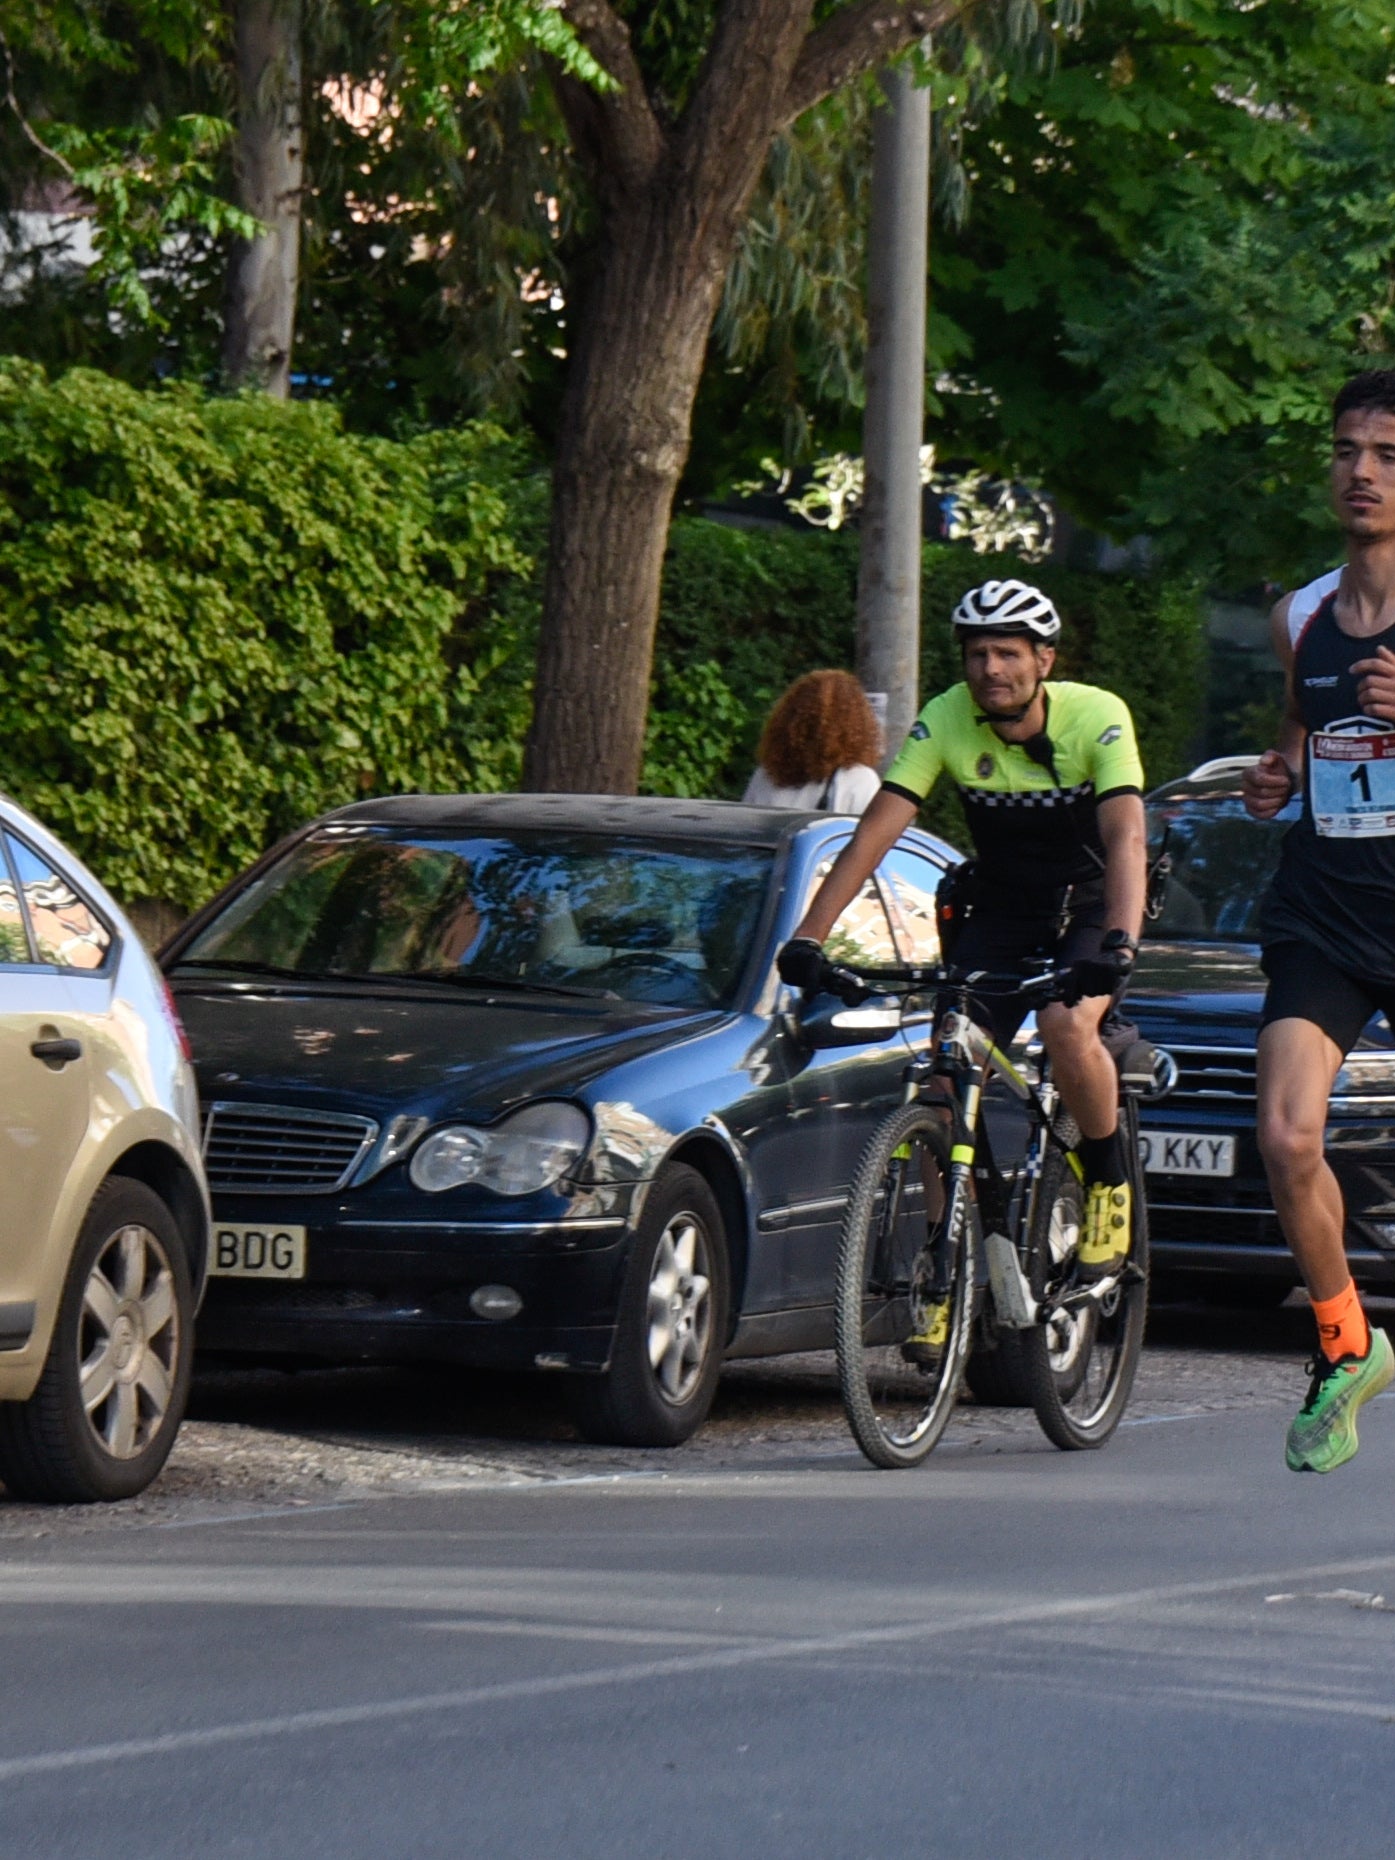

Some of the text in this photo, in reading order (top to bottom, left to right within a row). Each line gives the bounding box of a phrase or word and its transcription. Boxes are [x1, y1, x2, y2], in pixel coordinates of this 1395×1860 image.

[1350, 763, 1372, 802] 1
[1163, 1136, 1224, 1170] KKY
[217, 1230, 293, 1270] BDG
